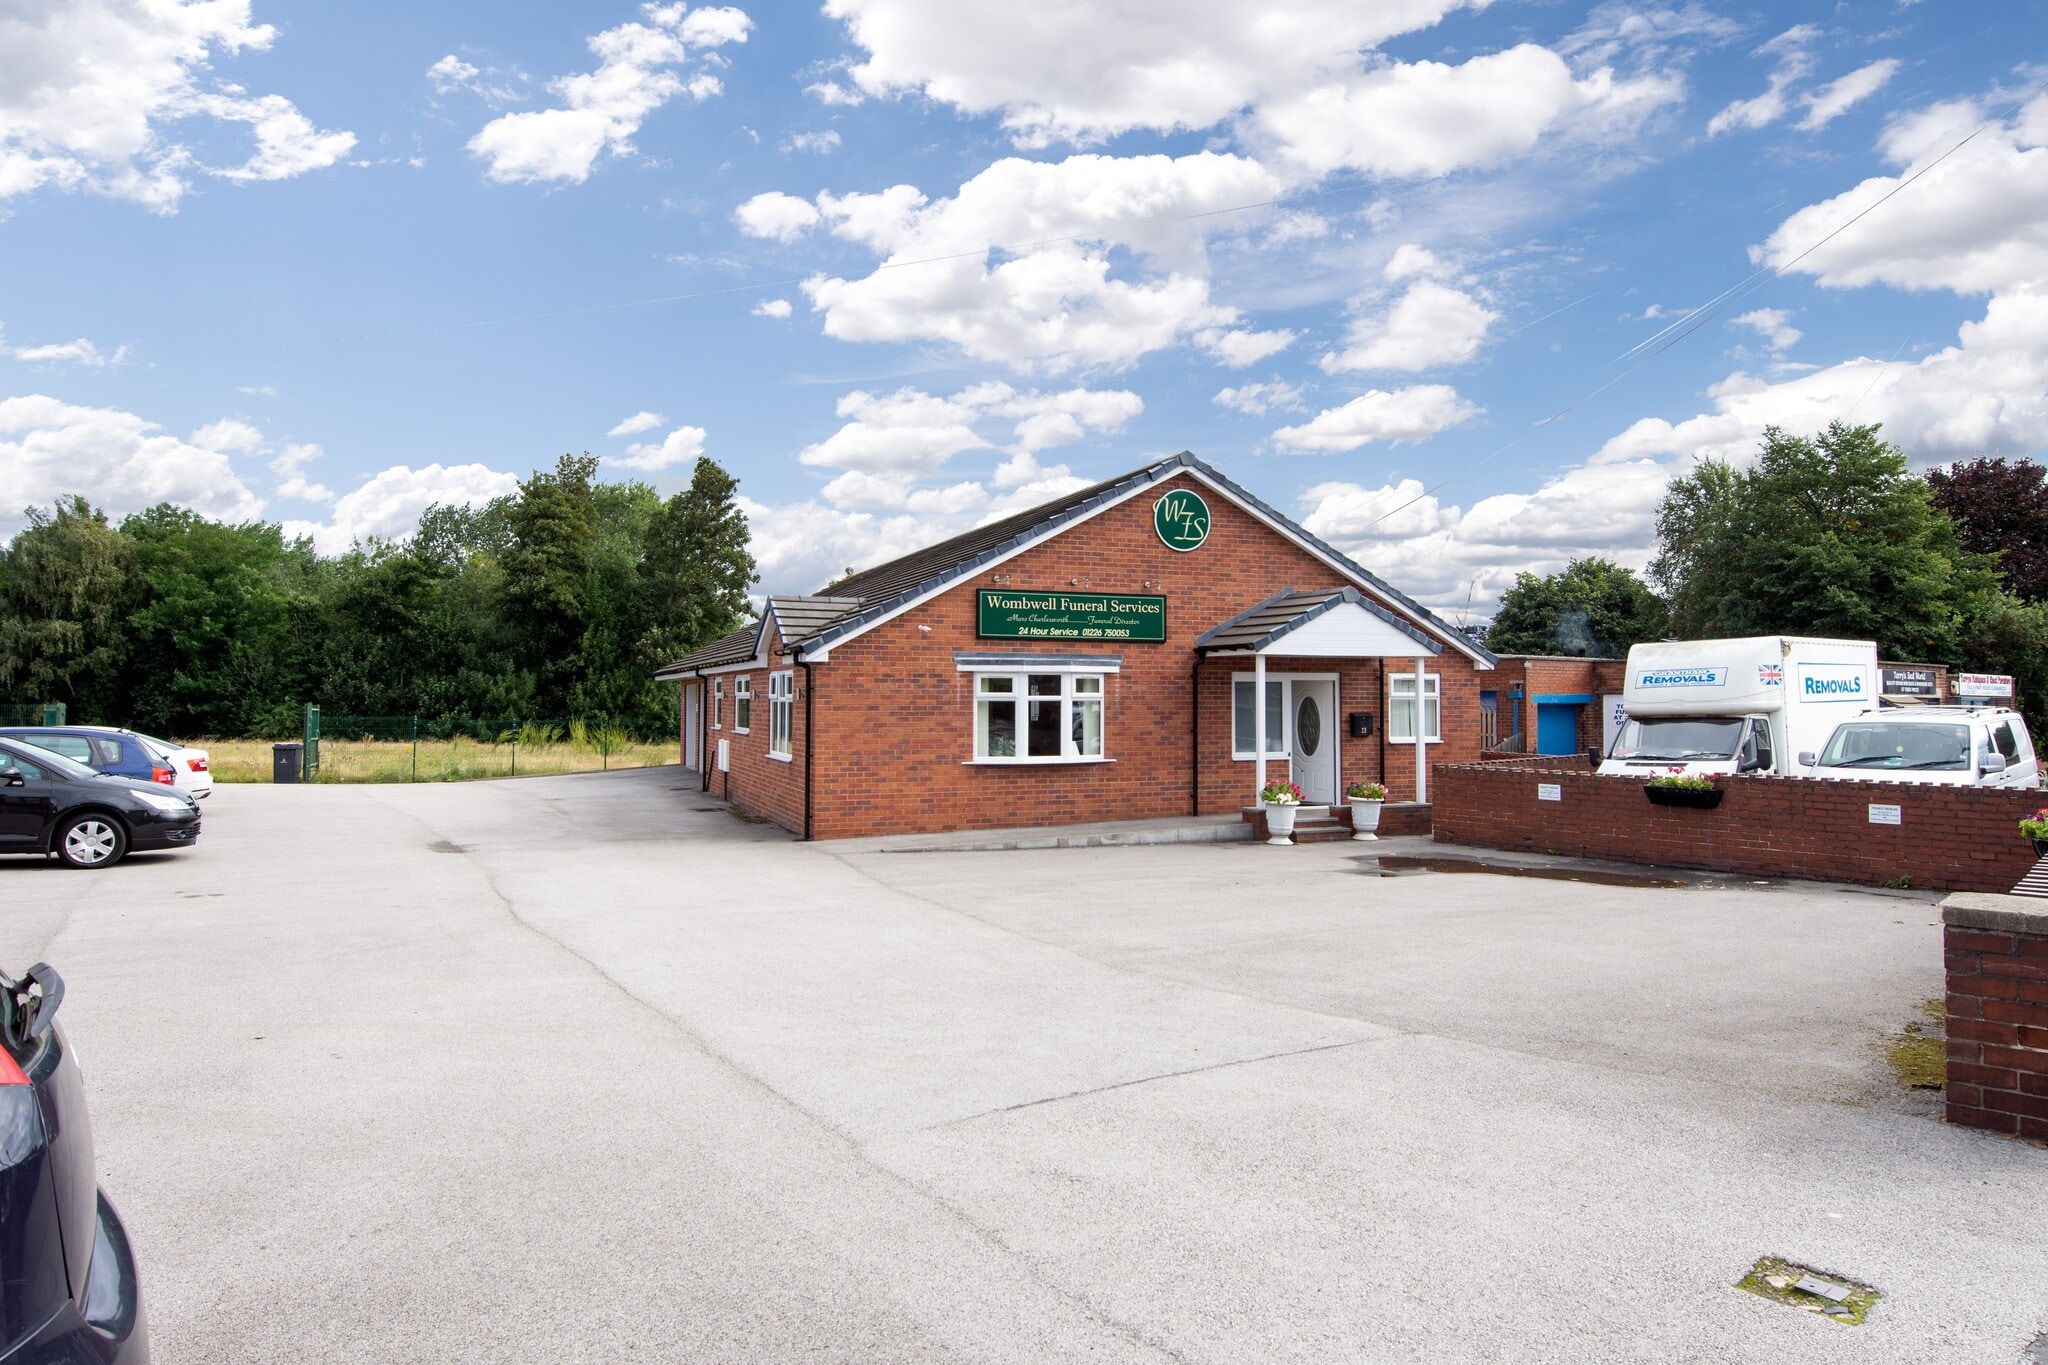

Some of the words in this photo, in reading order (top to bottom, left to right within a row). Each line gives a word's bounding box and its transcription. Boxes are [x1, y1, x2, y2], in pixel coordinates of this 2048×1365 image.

[987, 595, 1057, 610] Wombwell
[1060, 598, 1107, 612] Funeral
[1110, 599, 1160, 613] Services
[1006, 614, 1027, 622] Marc
[1028, 614, 1069, 623] Charlesworth
[1087, 615, 1113, 625] Funeral
[1113, 616, 1140, 625] Director
[1018, 627, 1029, 635] 24
[1030, 627, 1048, 636] Hour
[1049, 627, 1079, 636] Service
[1082, 628, 1102, 636] 01226
[1104, 629, 1130, 637] 750053
[1643, 673, 1715, 685] REMOVALS
[1804, 676, 1862, 695] REMOVALS
